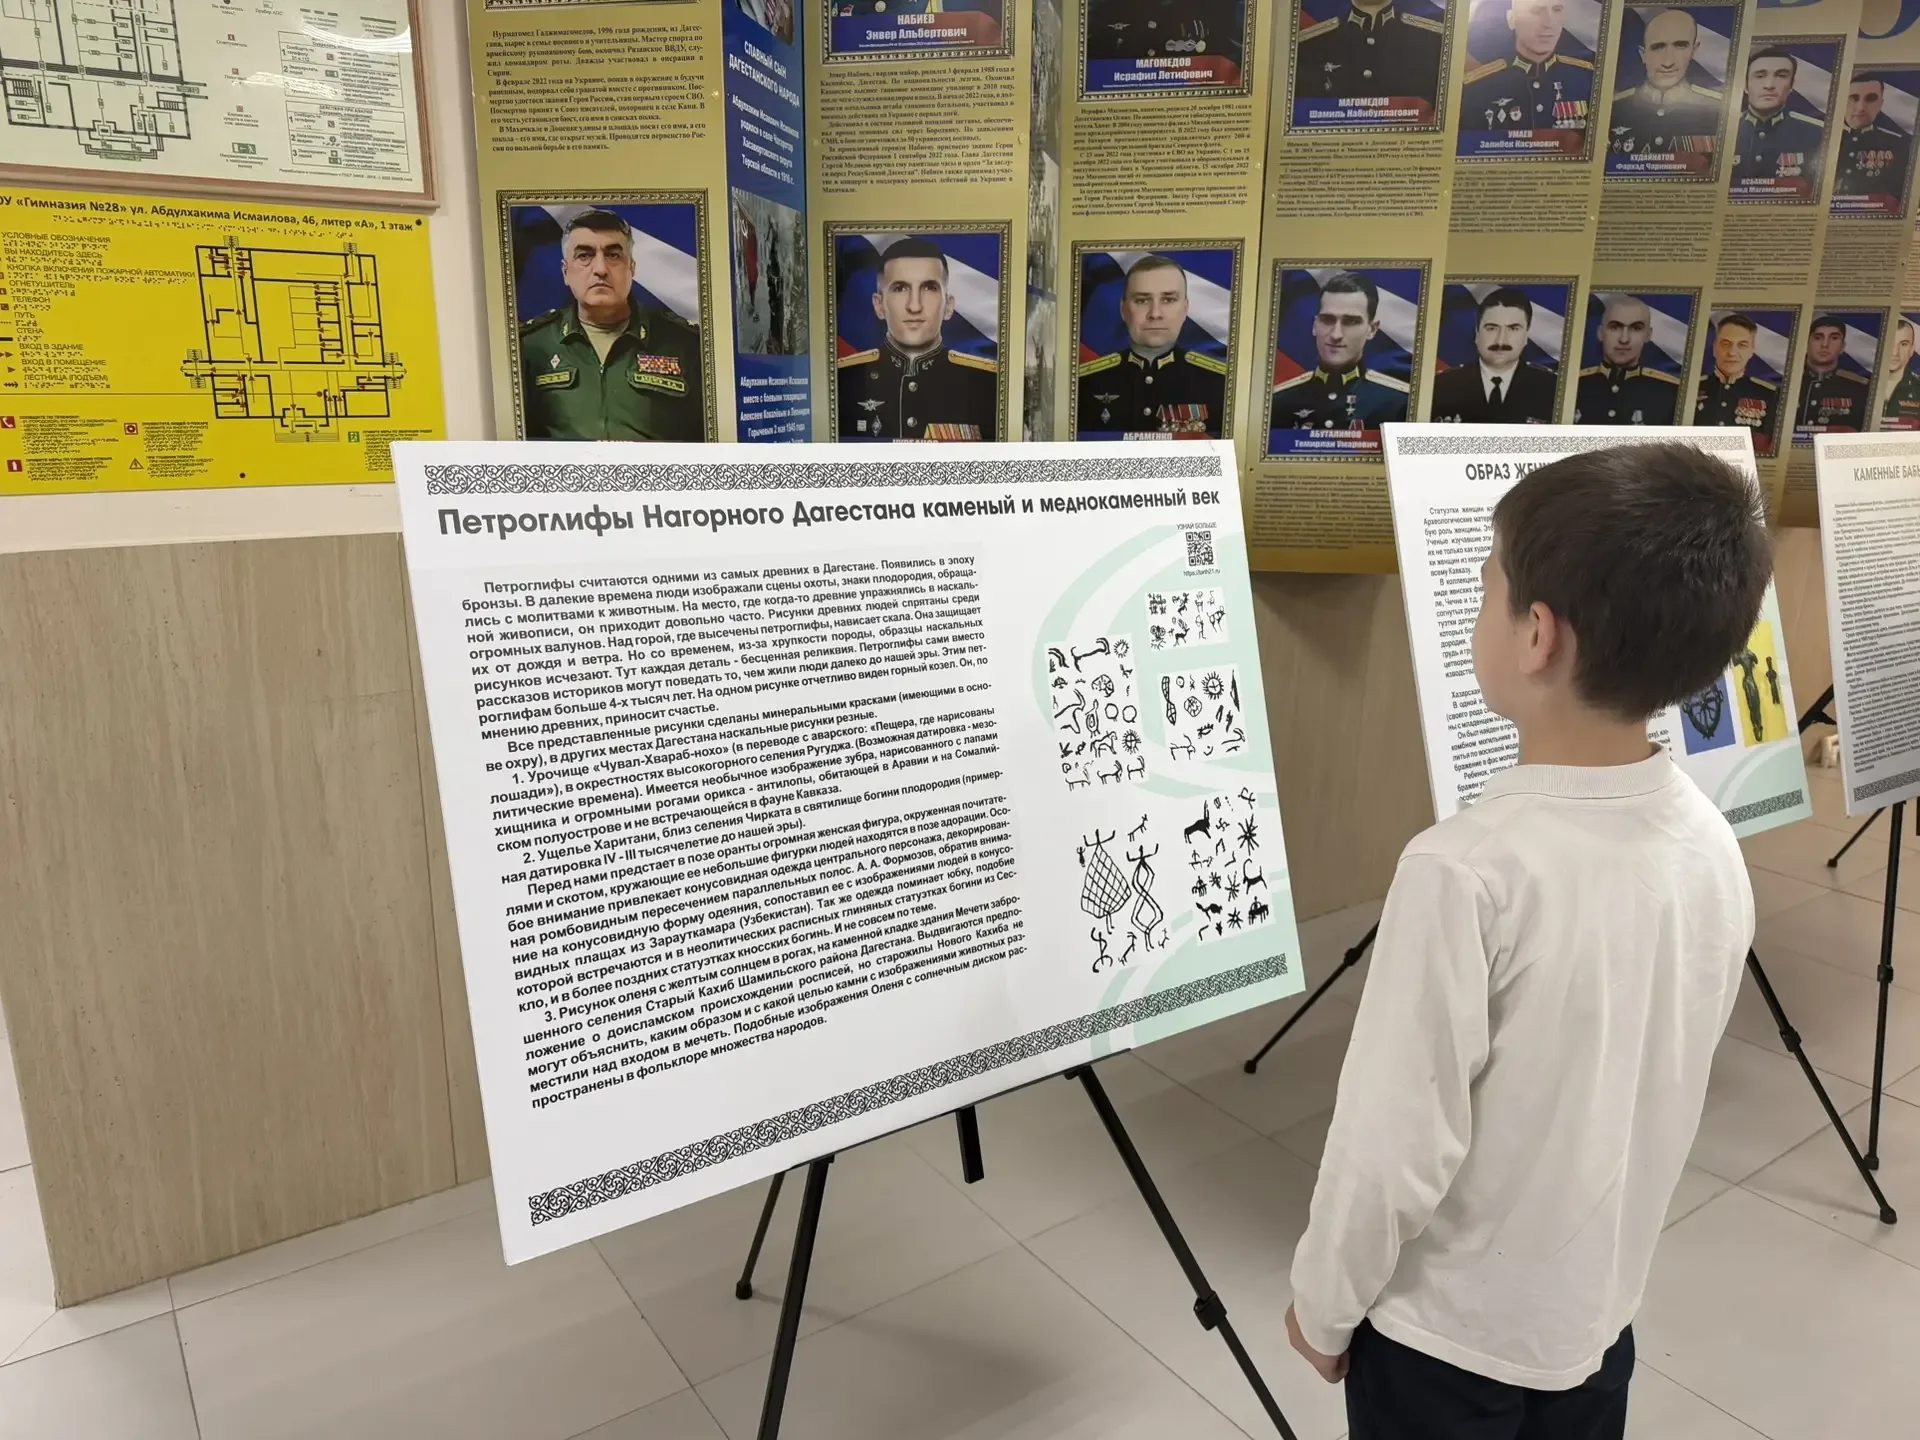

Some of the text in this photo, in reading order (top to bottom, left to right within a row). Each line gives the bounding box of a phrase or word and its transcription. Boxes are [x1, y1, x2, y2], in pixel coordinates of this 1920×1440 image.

[897, 13, 935, 26] НАБИЕВ
[866, 27, 967, 41] Энвер Альбертович
[744, 41, 787, 79] СЛАВНЫЙ СЫН
[1136, 57, 1191, 69] МАГОМЕДОВ
[729, 53, 800, 107] ДАГЕСТАНСКОГО НАРОДА
[1114, 69, 1213, 82] Исрафил Летифович
[1338, 97, 1390, 107] МАГОМЕДОВ
[1309, 108, 1419, 118] Шамиль Набибуллагович
[1508, 130, 1533, 138] УМАЕВ
[17, 198, 86, 211] «Гимназия
[90, 202, 127, 213] №28»
[130, 205, 148, 216] ул.
[151, 205, 230, 219] Абдулхакима
[233, 211, 300, 225] Исмаилова,
[302, 216, 319, 227] 46,
[321, 218, 352, 229] литер
[354, 219, 378, 230] «А»,
[389, 222, 413, 232] этаж
[1, 232, 111, 243] УСЛОВНЫЕ ОБОЗНАЧЕНИЯ
[20, 249, 74, 257] НАХОДИТЕСЬ
[76, 251, 103, 259] ЗДЕСЬ
[7, 264, 195, 278] КНОПКА ВКЛЮЧЕНИЯ ПОЖАРНОЙ АВТОМАТИКИ
[9, 280, 75, 289] ОГНЕТУШИТЕЛЬ
[54, 359, 107, 367] ПОМЕЩЕНИЕ
[24, 374, 108, 382] ЛЕСТНИЦА (ПОДЪЕМ)
[1122, 432, 1173, 441] АБРАМЕНКО
[1465, 463, 1511, 481] ОБРАЗ
[1853, 466, 1901, 482] КАМЕННЫЕ
[438, 488, 1220, 540] Петроглифы Нагорного Дагестана каменый и меднокаменный век
[1429, 506, 1459, 516] Статуэтки
[1176, 521, 1217, 530] УЗНАЙ БОЛЬШЕ
[1424, 517, 1472, 526] Археологические
[1425, 526, 1482, 537] бую роль женщины.
[483, 556, 975, 595] Петроглифы считаются одними из самых древних в Дагестане. Появились в эпоху
[461, 568, 977, 614] бронзы. В далекие времена люди изображали сцены охоты, знаки плодородия, обраща-
[464, 581, 979, 628] лись с молитвами к животным. На место, где когда-то древние упражнялись в наскаль-
[522, 770, 1004, 865] 2. Ущелье Харитани, близ селения Чирката в святилище богини плодородия (пример-
[531, 1016, 828, 1110] пространены в фольклоре множества народов.
